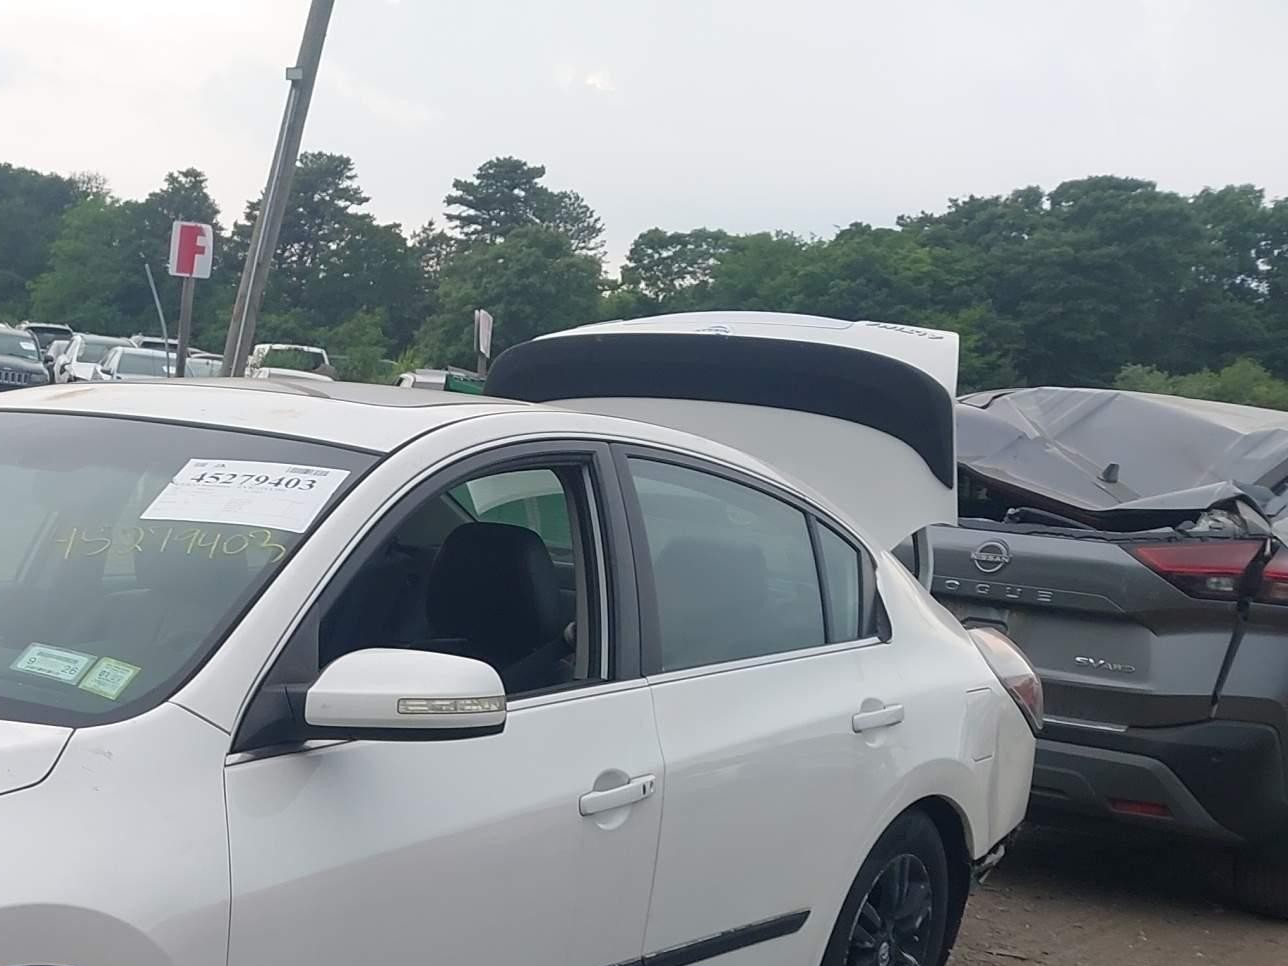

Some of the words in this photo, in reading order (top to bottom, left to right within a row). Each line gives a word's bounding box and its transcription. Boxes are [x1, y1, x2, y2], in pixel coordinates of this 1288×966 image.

[176, 225, 206, 275] F
[190, 472, 317, 491] 45279403
[970, 552, 1011, 563] NISSAN
[944, 579, 1054, 602] OGUE
